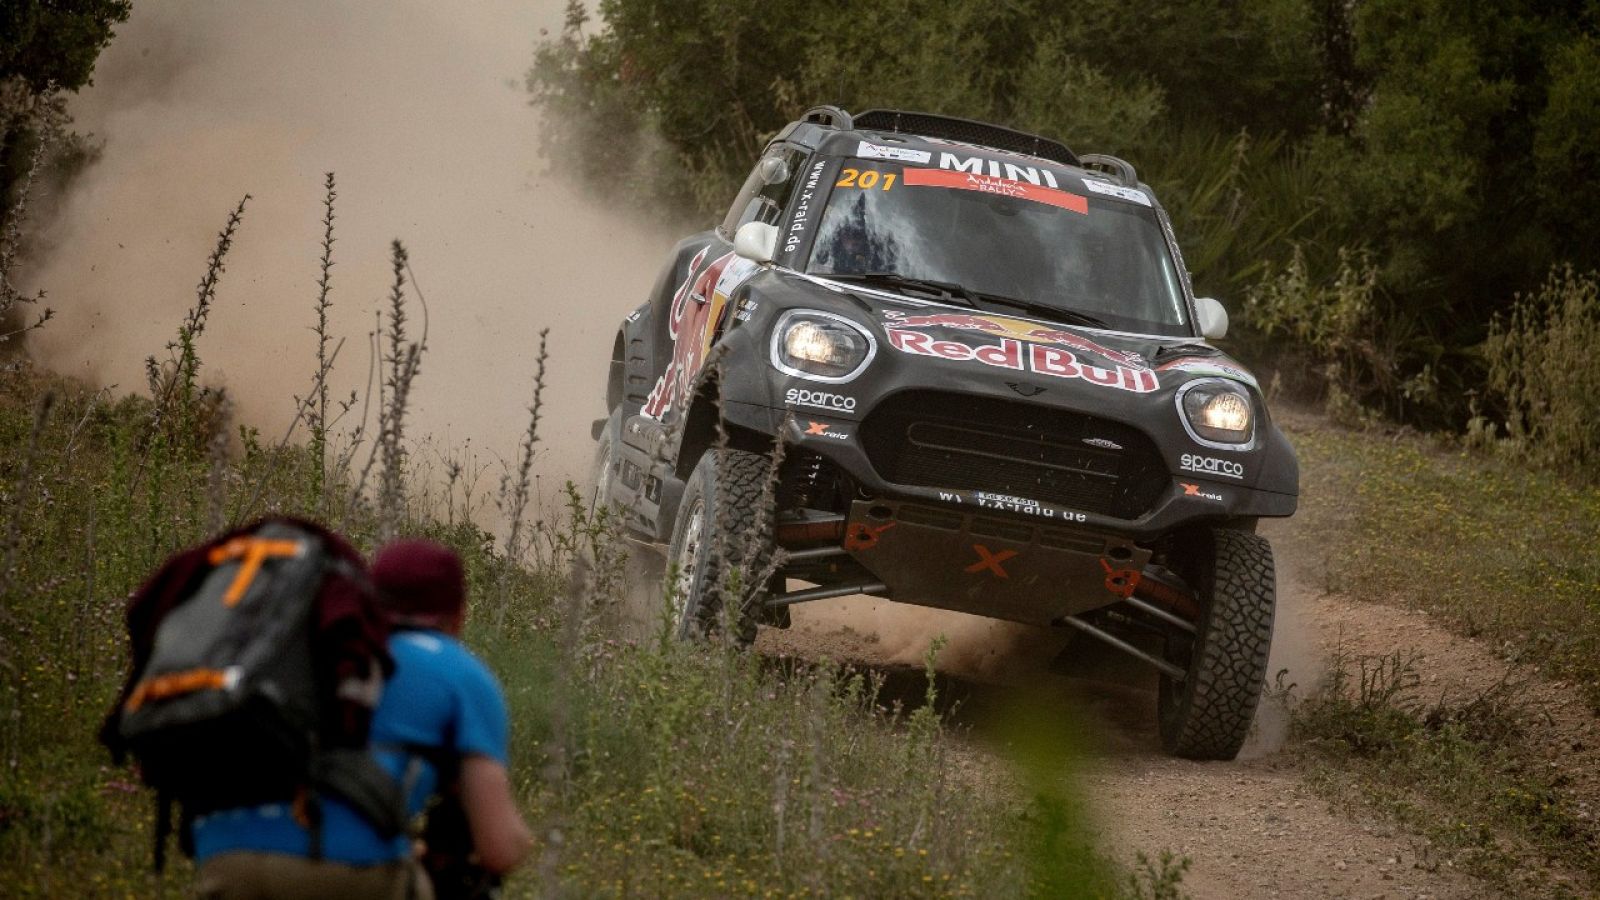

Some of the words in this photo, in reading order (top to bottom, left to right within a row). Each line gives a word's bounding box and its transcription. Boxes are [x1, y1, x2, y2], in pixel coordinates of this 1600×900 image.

[836, 168, 896, 191] 201
[940, 151, 1058, 188] MINI
[979, 184, 1016, 197] RALLY
[785, 160, 826, 252] www.x-raid.de
[884, 326, 1025, 371] Red
[1028, 343, 1161, 393] Bull
[785, 388, 856, 412] sparco
[1180, 453, 1243, 478] sparco
